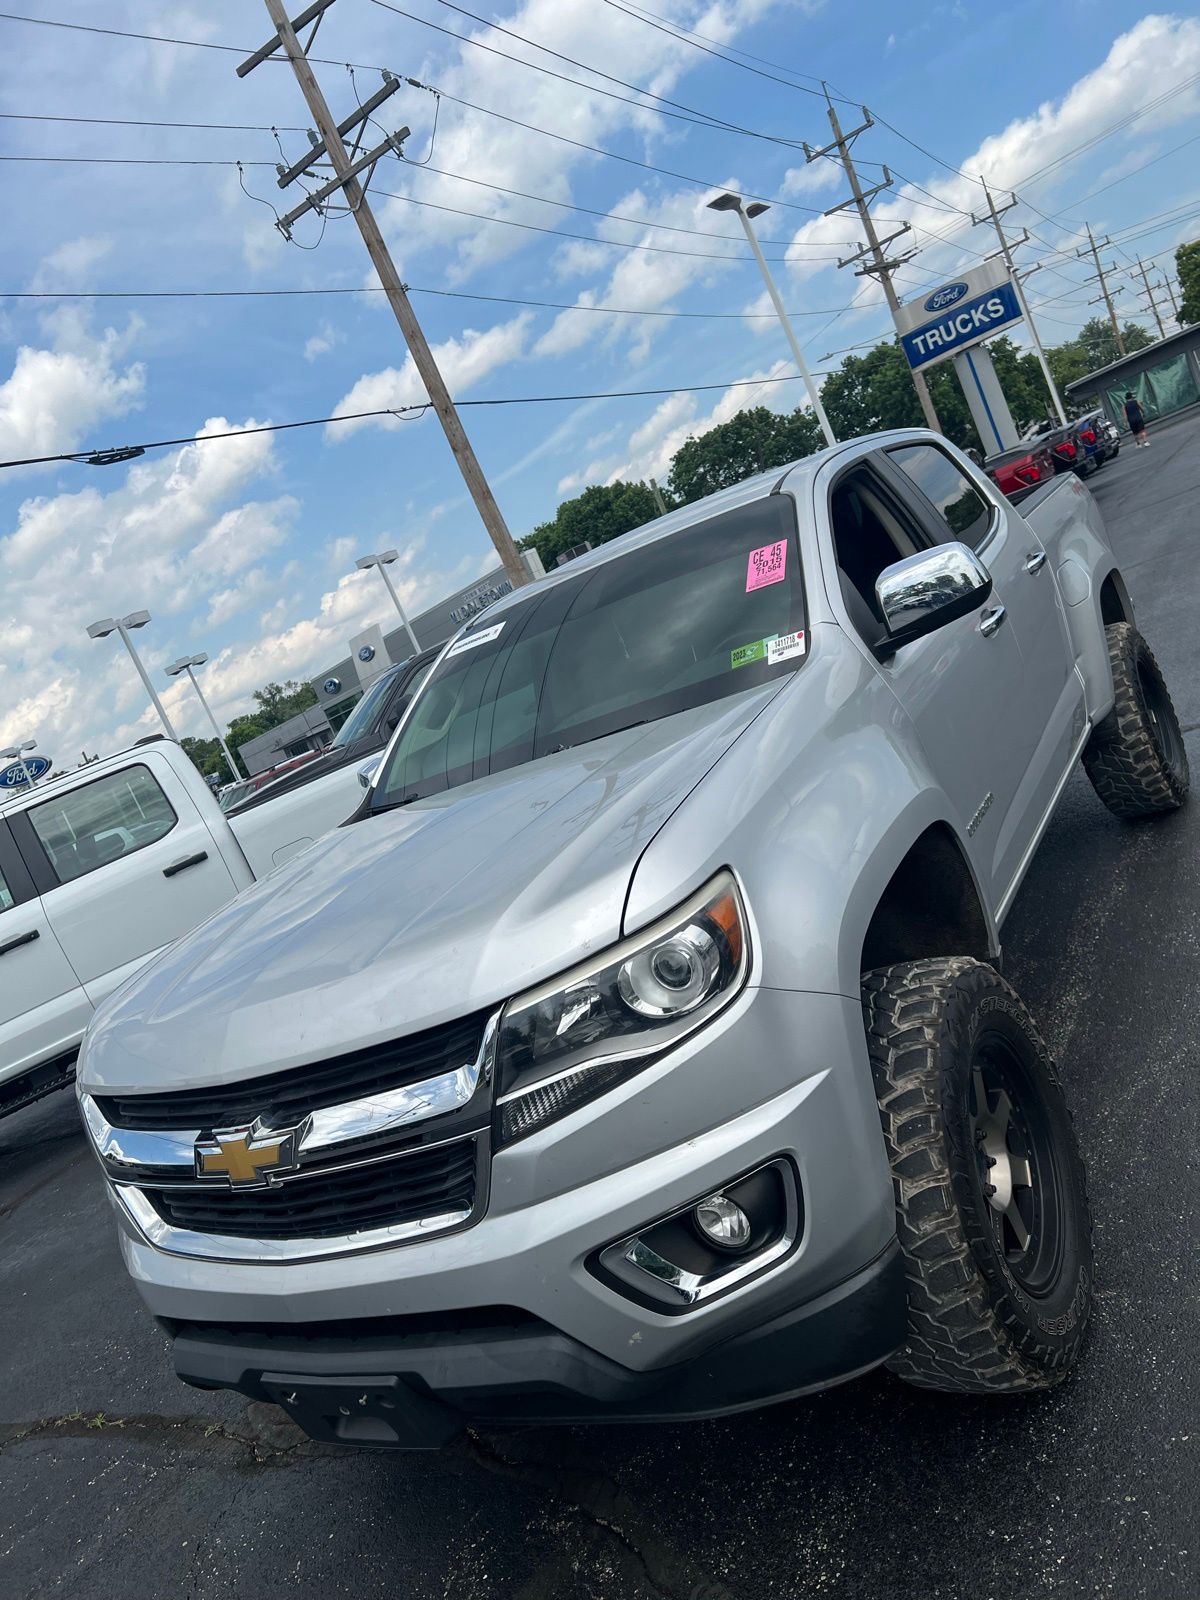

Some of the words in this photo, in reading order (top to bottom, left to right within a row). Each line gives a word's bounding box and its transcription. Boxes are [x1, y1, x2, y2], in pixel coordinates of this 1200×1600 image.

[933, 288, 960, 308] Ford
[912, 298, 1004, 355] TRUCKS
[752, 550, 765, 565] CE
[770, 544, 782, 558] 45
[755, 556, 783, 571] 2015
[732, 649, 747, 662] 2023
